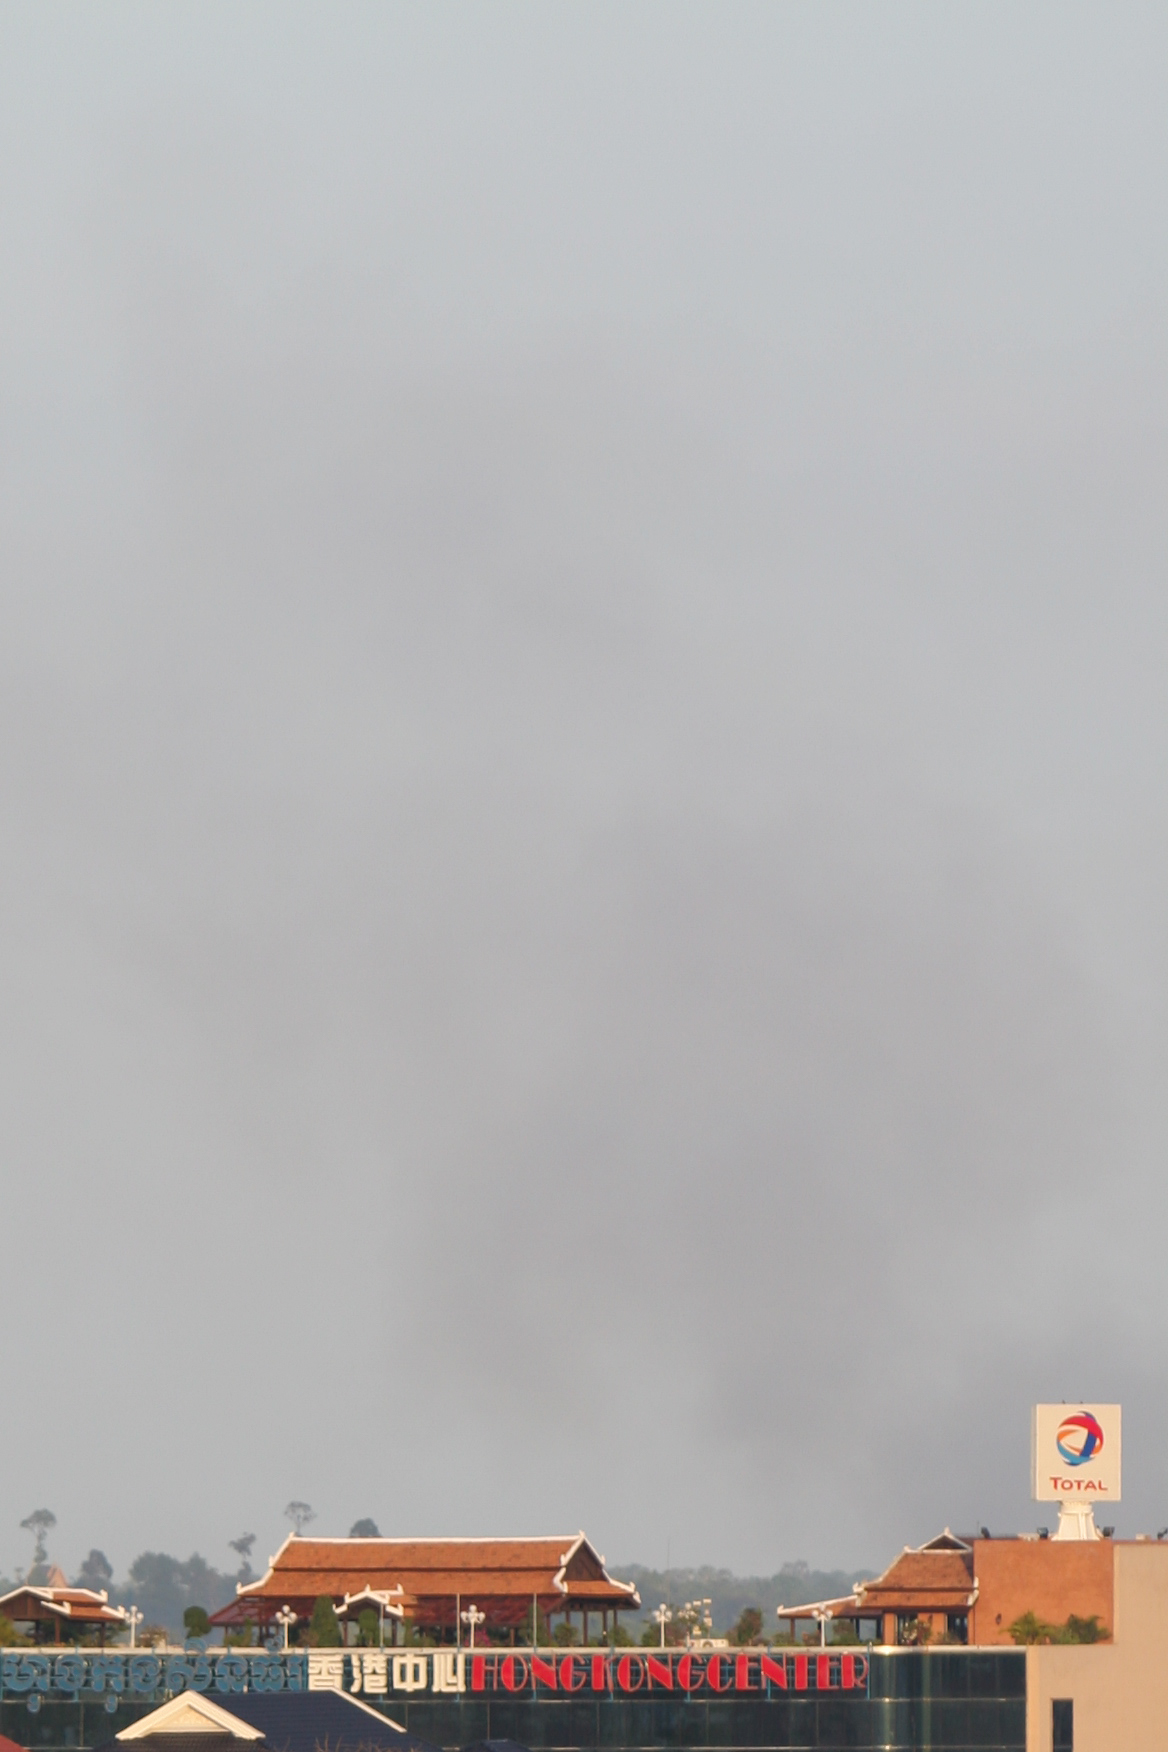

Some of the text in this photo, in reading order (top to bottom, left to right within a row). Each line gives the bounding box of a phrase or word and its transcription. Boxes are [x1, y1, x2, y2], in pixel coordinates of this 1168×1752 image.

[1049, 1477, 1108, 1491] TOTAL
[308, 1653, 466, 1694] 香港中心
